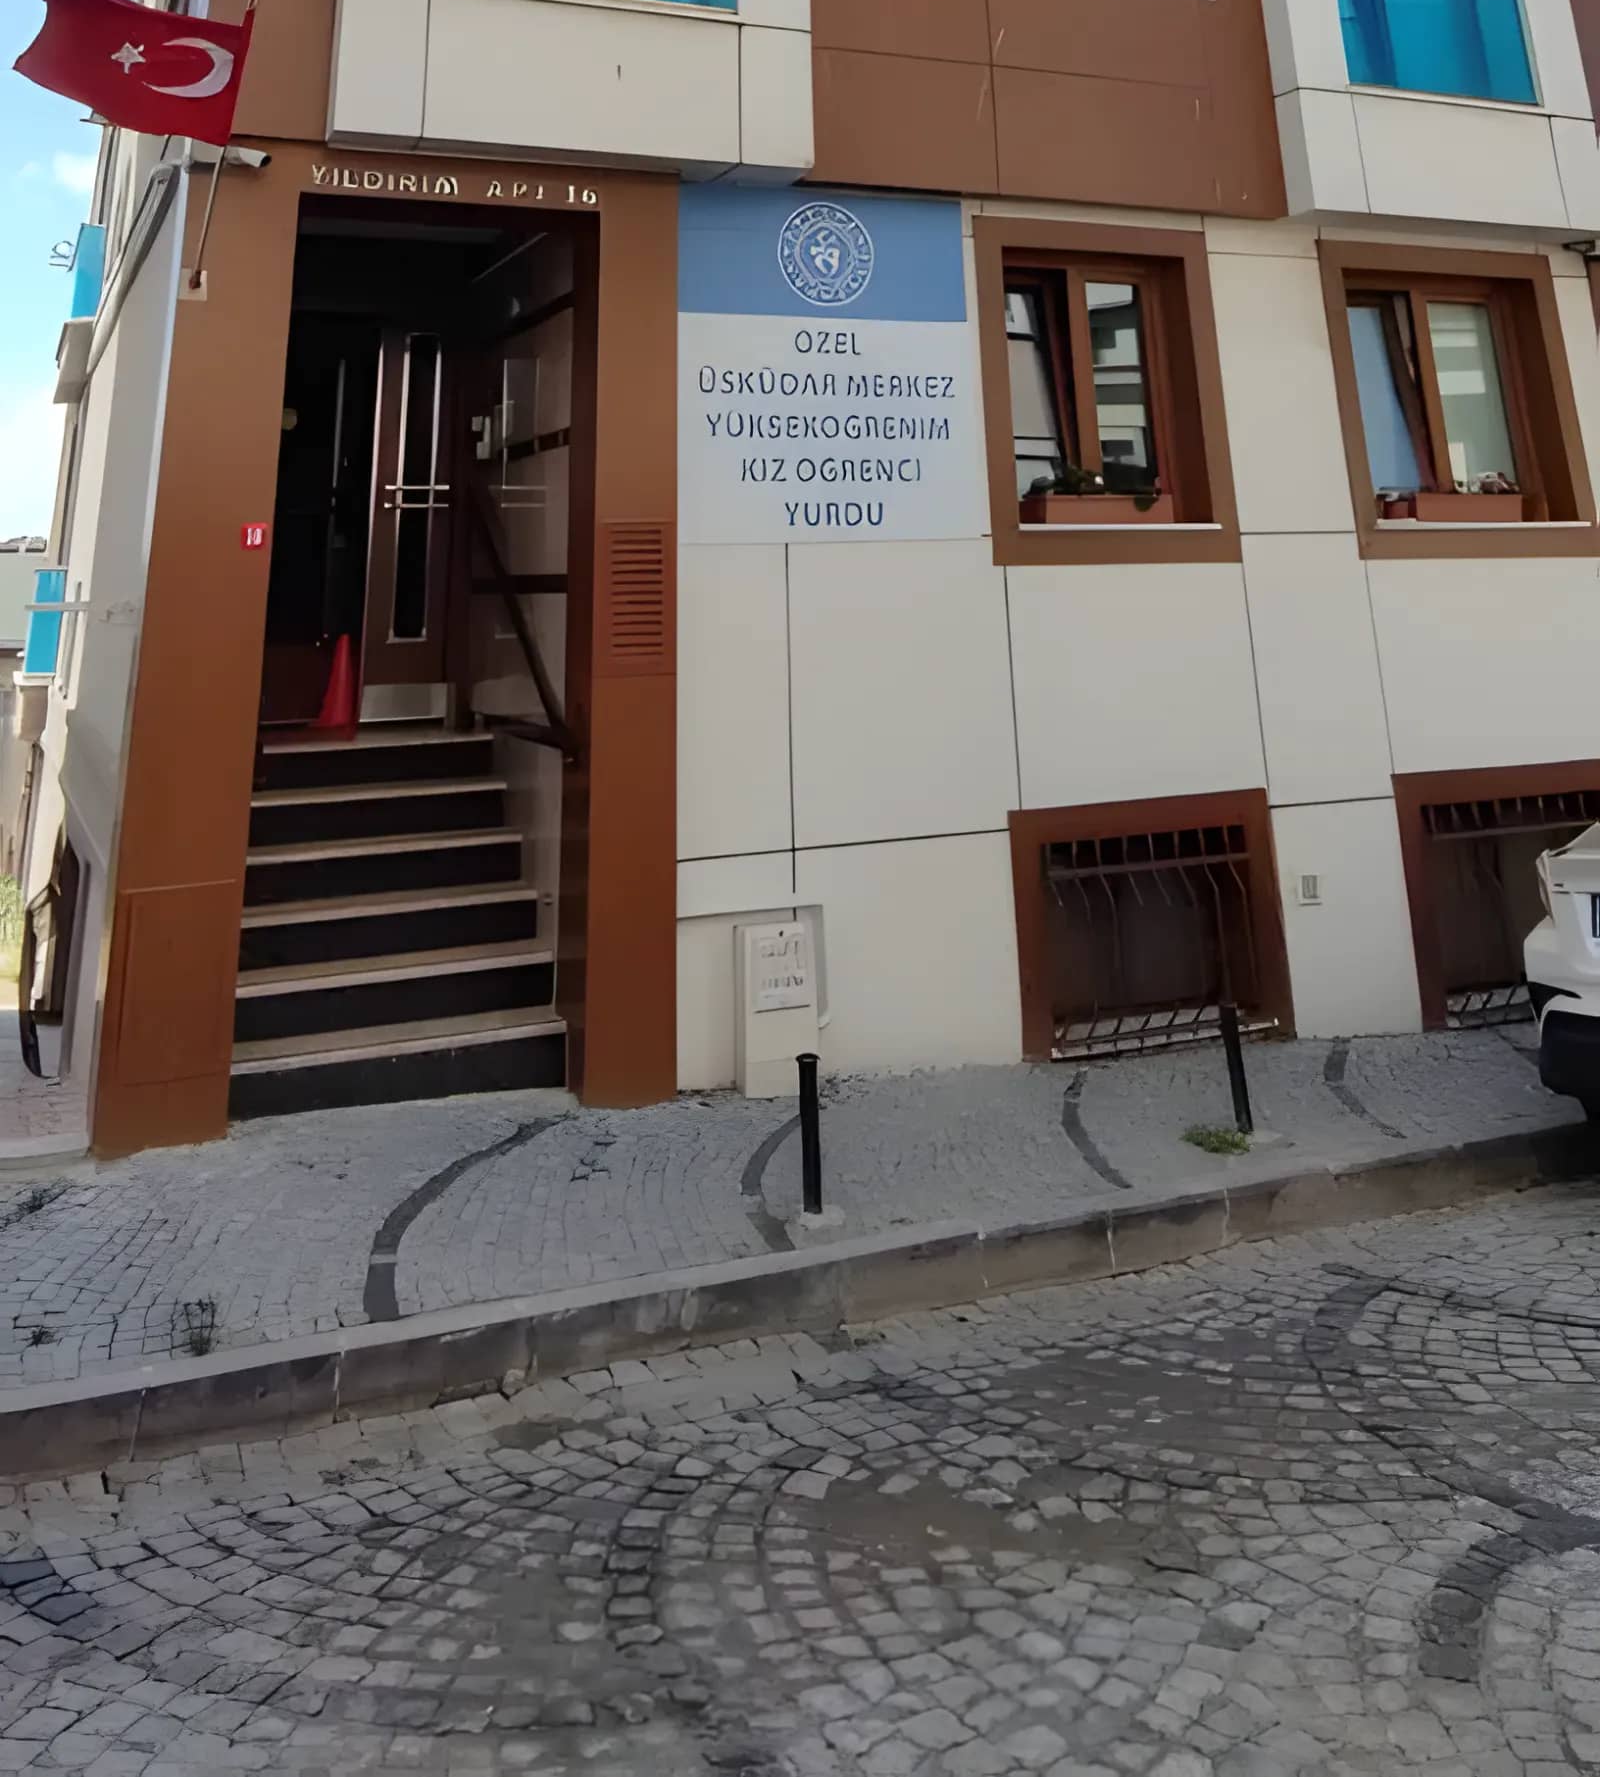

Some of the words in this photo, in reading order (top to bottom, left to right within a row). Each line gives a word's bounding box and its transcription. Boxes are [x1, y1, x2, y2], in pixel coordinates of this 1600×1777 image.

[311, 164, 459, 195] YILDIRIM
[846, 374, 956, 398] MERKEZ
[740, 457, 787, 482] KIZ
[784, 501, 884, 526] YURDU
